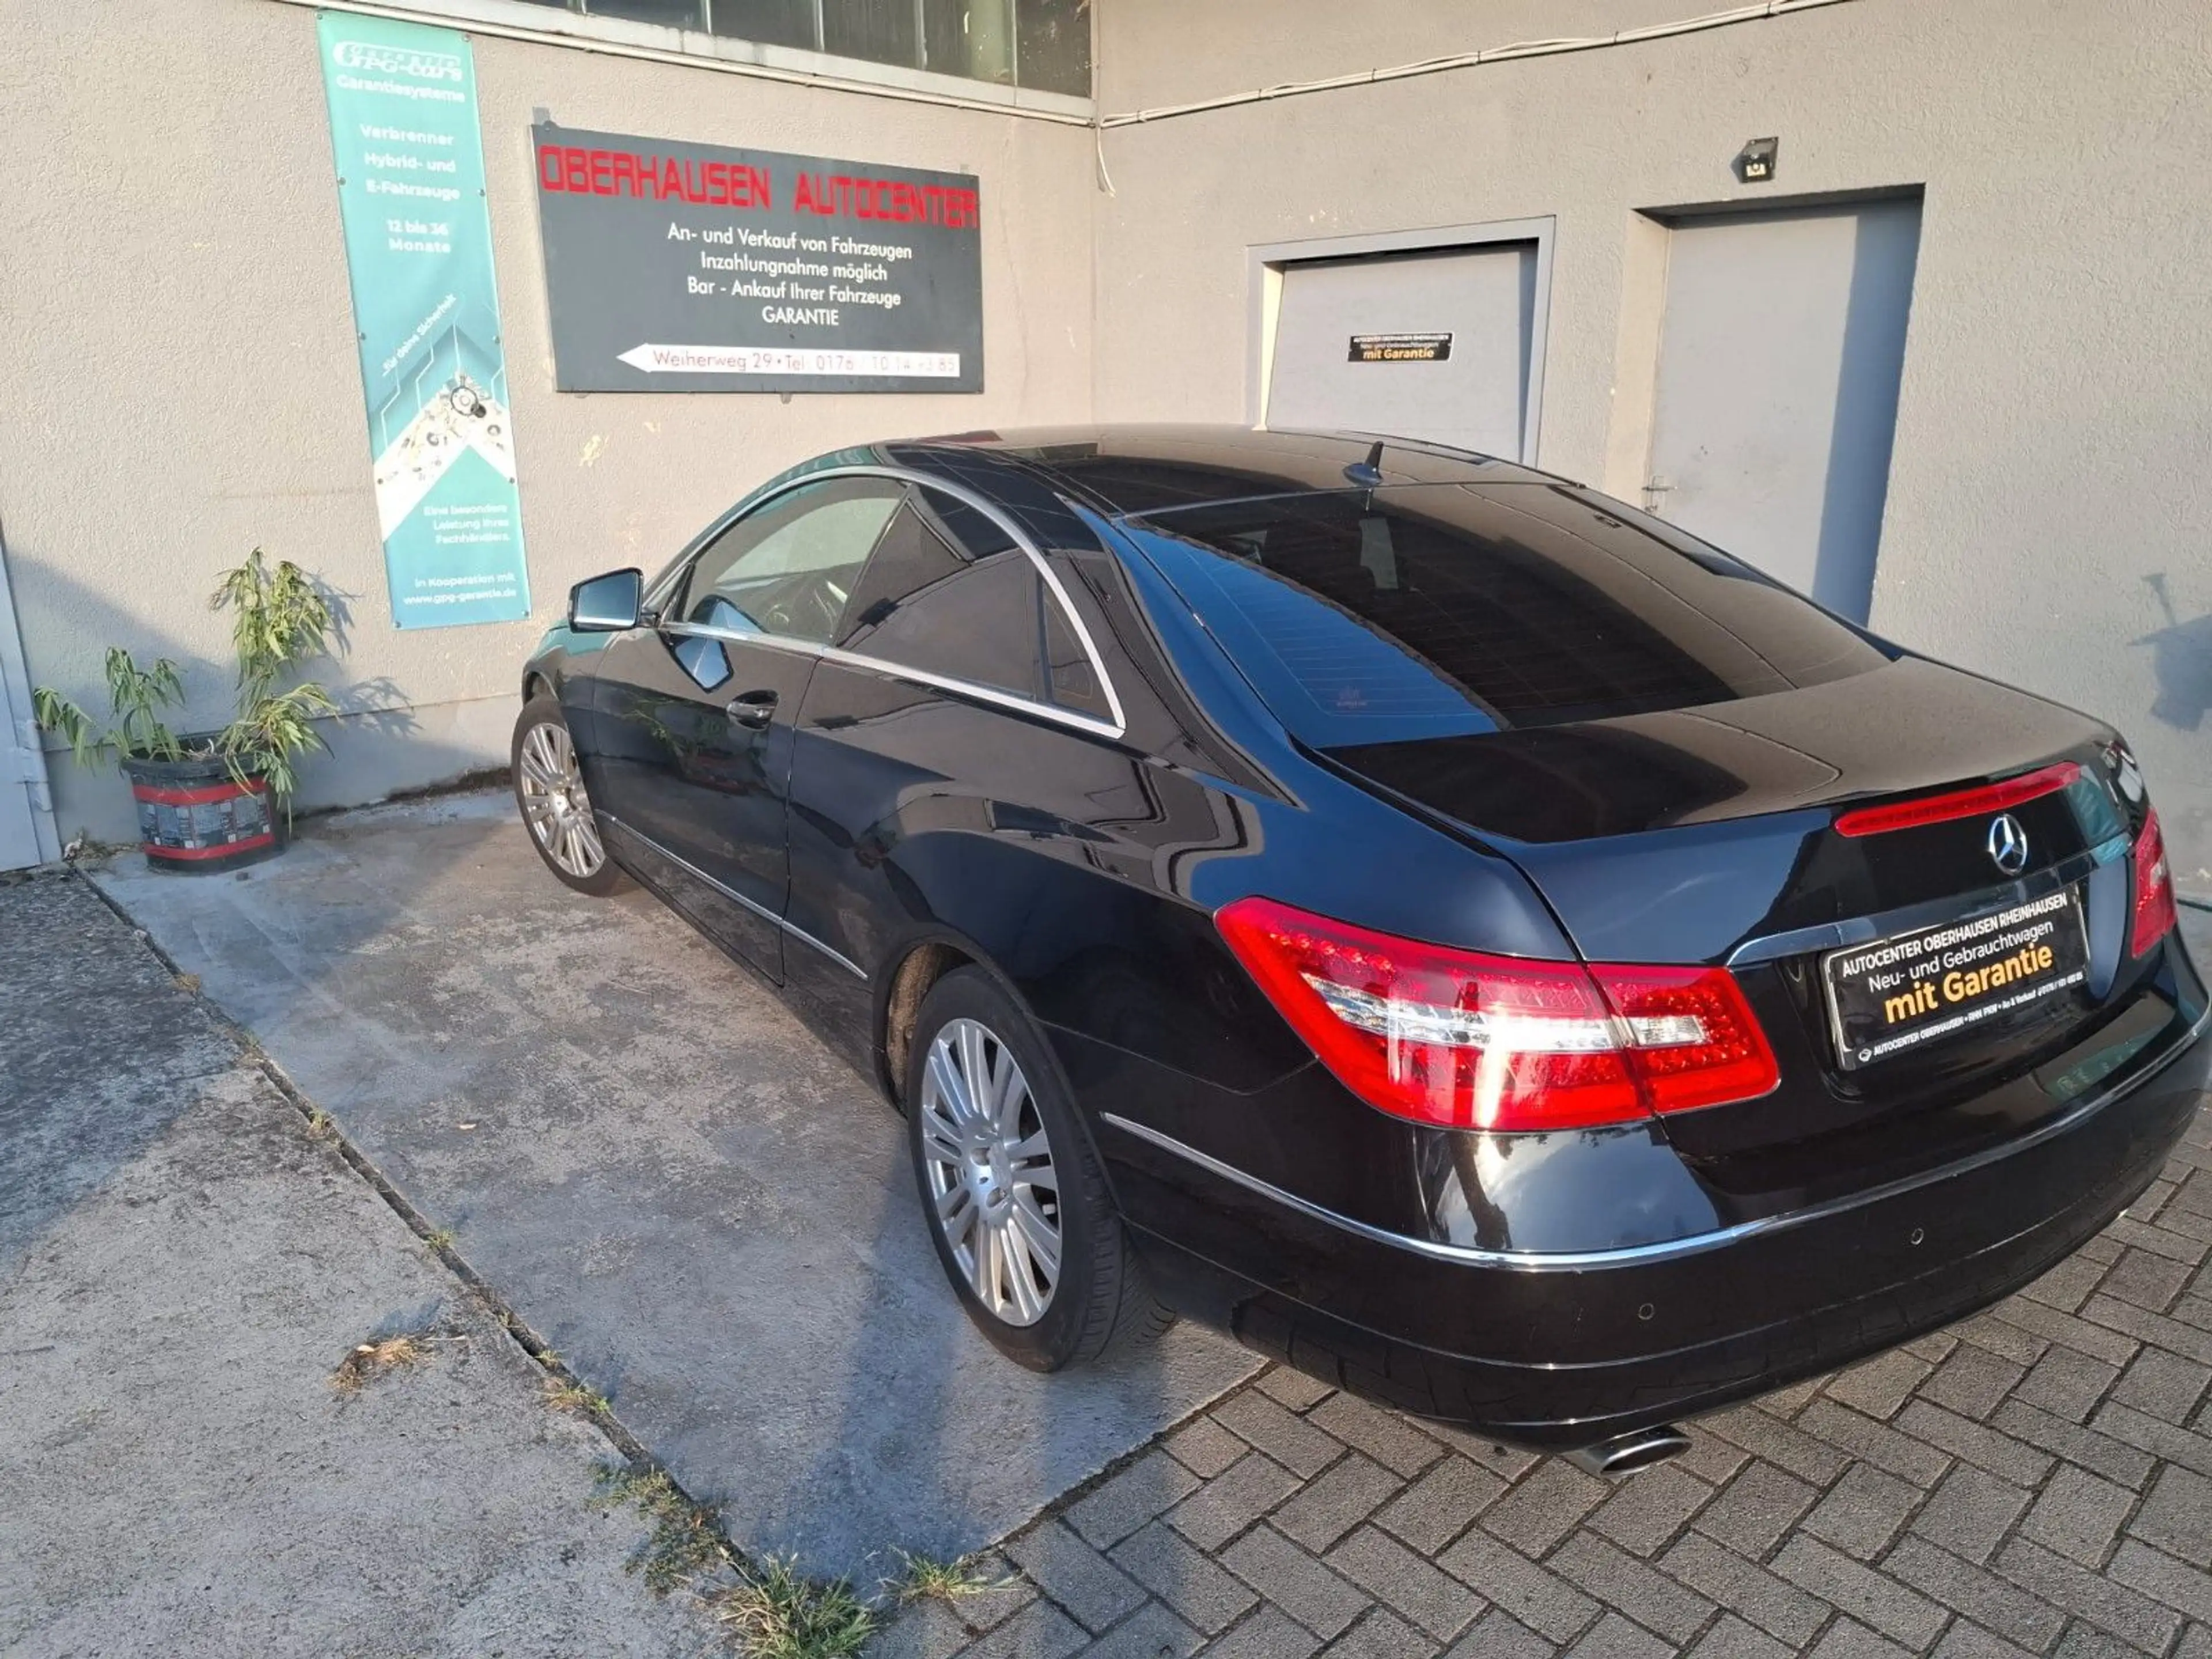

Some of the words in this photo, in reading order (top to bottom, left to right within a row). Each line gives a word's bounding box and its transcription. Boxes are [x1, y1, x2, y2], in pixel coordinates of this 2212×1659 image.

[359, 123, 455, 146] Verbrenner
[364, 151, 423, 168] Hybrid-
[426, 159, 456, 173] und
[365, 179, 460, 202] E-Fahrzeuge
[539, 145, 771, 210] OBERHAUSEN
[794, 173, 978, 228] AUTOCENTER
[385, 218, 402, 233] 12
[388, 237, 451, 253] Monate
[667, 222, 697, 241] An-
[703, 227, 734, 244] und
[737, 228, 797, 249] Verkauf
[800, 238, 827, 252] von
[831, 236, 912, 262] Fahrzeugen
[700, 251, 829, 277] Inzahlungnahme
[832, 262, 888, 283] möglich
[687, 276, 715, 294] Bar
[731, 279, 786, 299] Ankauf
[790, 283, 825, 301] Ihrer
[828, 285, 902, 309] Fahrzeuge
[761, 305, 840, 326] GARANTIE
[653, 349, 747, 372] Weiherweg
[752, 352, 772, 369] 29
[1363, 350, 1381, 359] mit
[1384, 347, 1434, 359] Garantie
[1843, 938, 1922, 978] AUTOCENTER
[1924, 916, 1999, 952] OBERHAUSEN
[2001, 892, 2068, 927] RHEINHAUSEN
[1868, 973, 1906, 993] Neu-
[1910, 959, 1941, 979] und
[1944, 921, 2054, 968] Gebrauchtwagen
[1884, 981, 1940, 1024] mit
[1943, 943, 2054, 1003] Garantie
